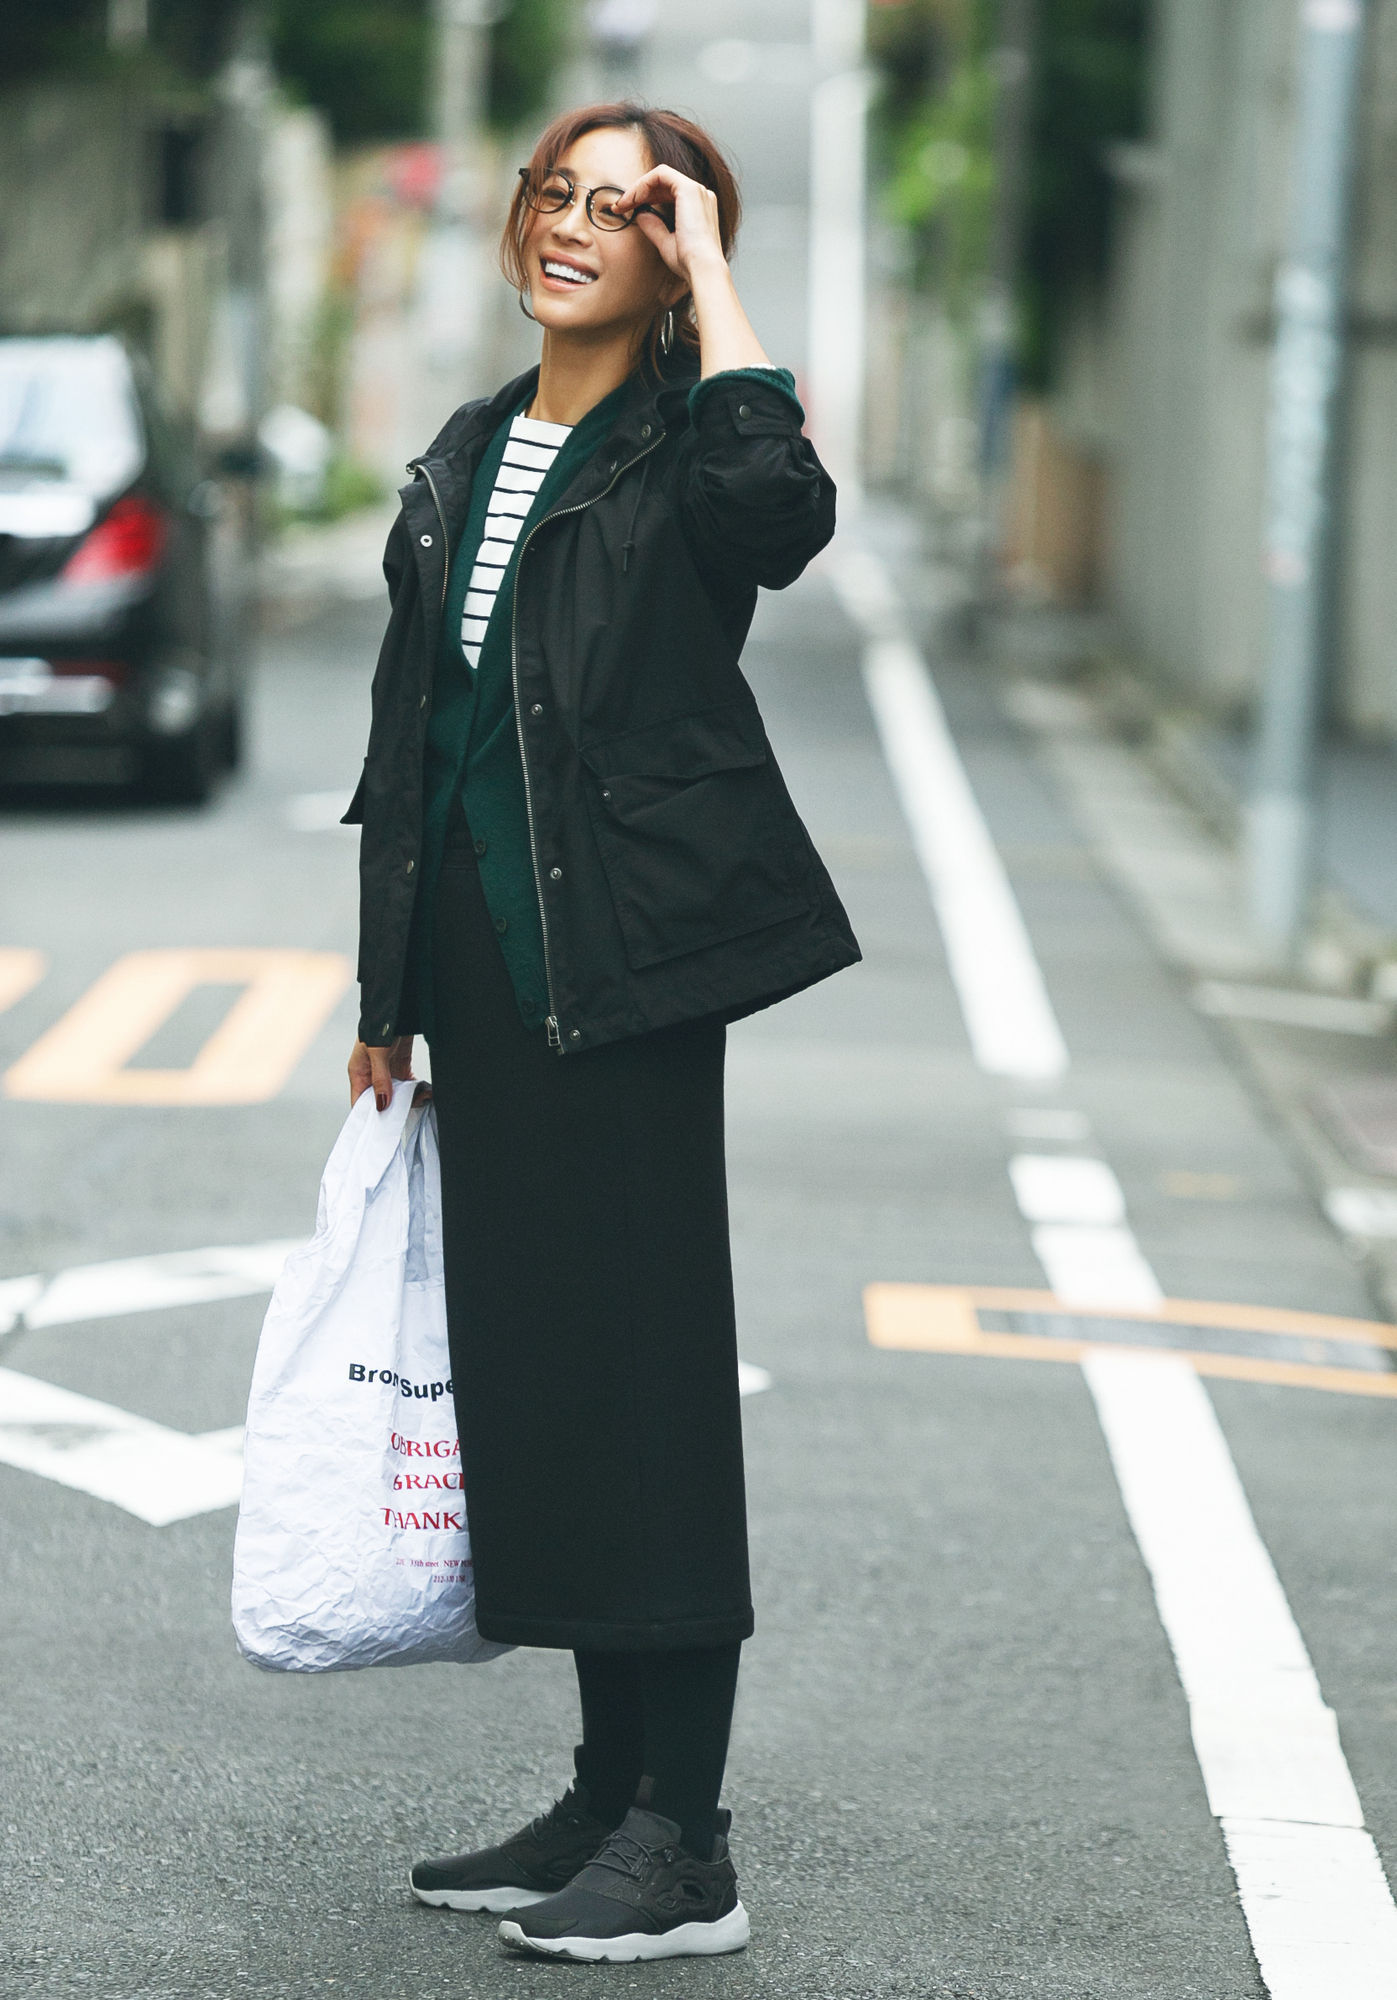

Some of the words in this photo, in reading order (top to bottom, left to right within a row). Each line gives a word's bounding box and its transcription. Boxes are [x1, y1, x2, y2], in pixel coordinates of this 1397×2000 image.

[0, 946, 352, 1105] 0
[400, 1378, 454, 1402] Supe
[379, 1507, 463, 1530] THANK
[443, 1559, 460, 1568] NEW
